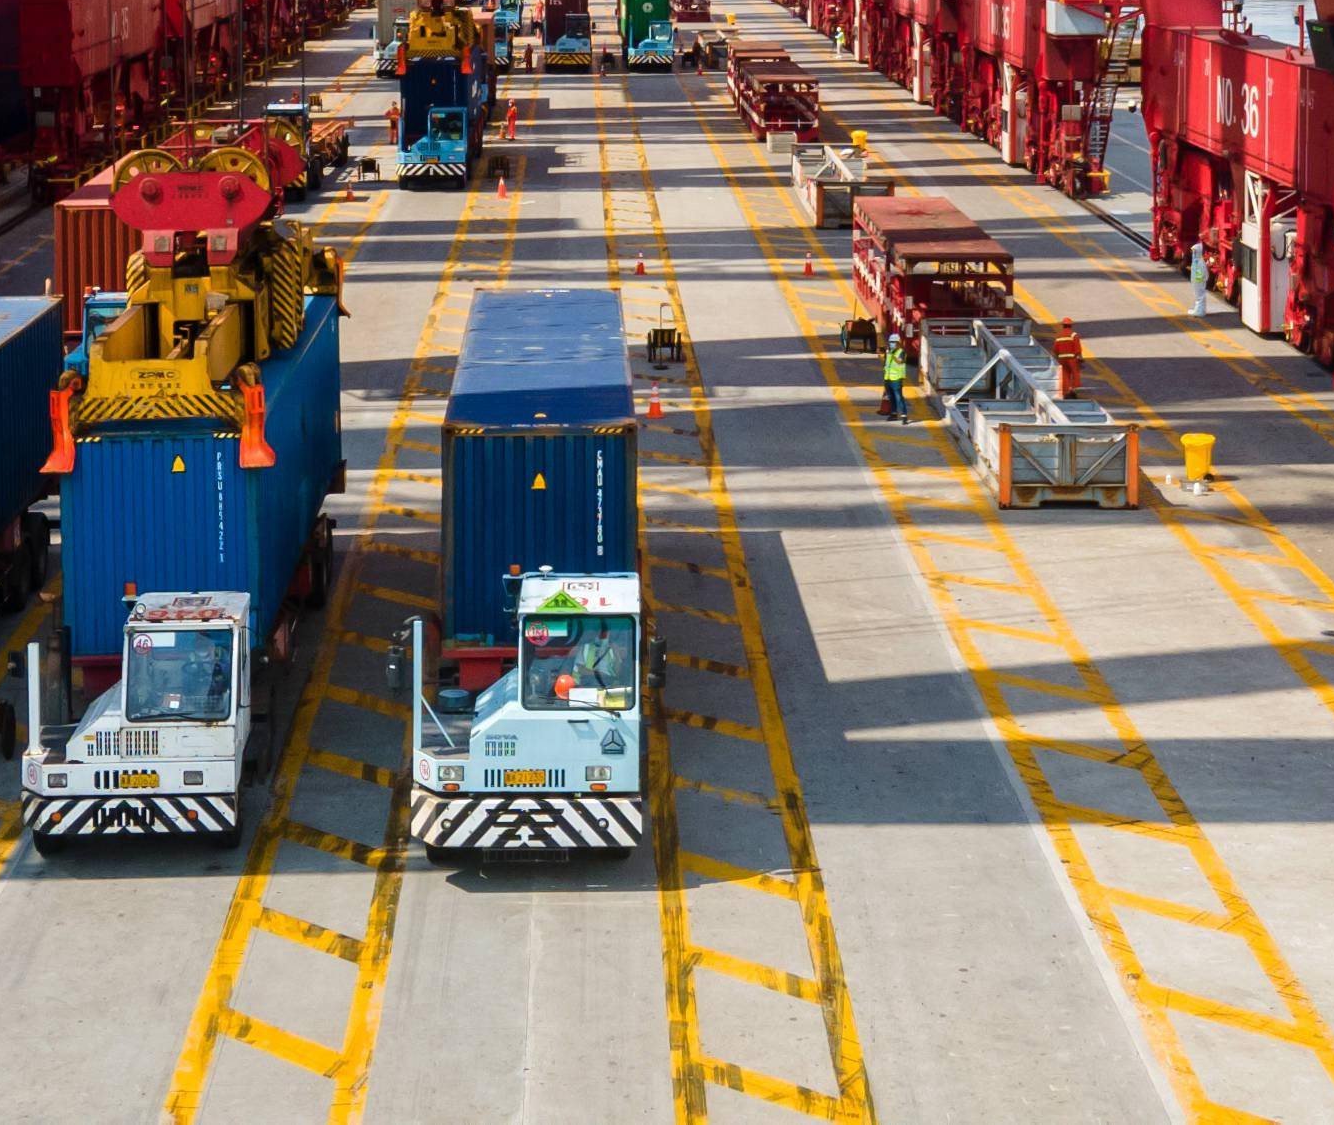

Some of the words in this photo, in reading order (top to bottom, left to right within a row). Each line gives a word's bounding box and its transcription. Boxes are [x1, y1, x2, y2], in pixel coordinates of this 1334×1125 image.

[1217, 75, 1236, 126] NO.
[1242, 83, 1260, 138] 36
[136, 638, 149, 649] 46
